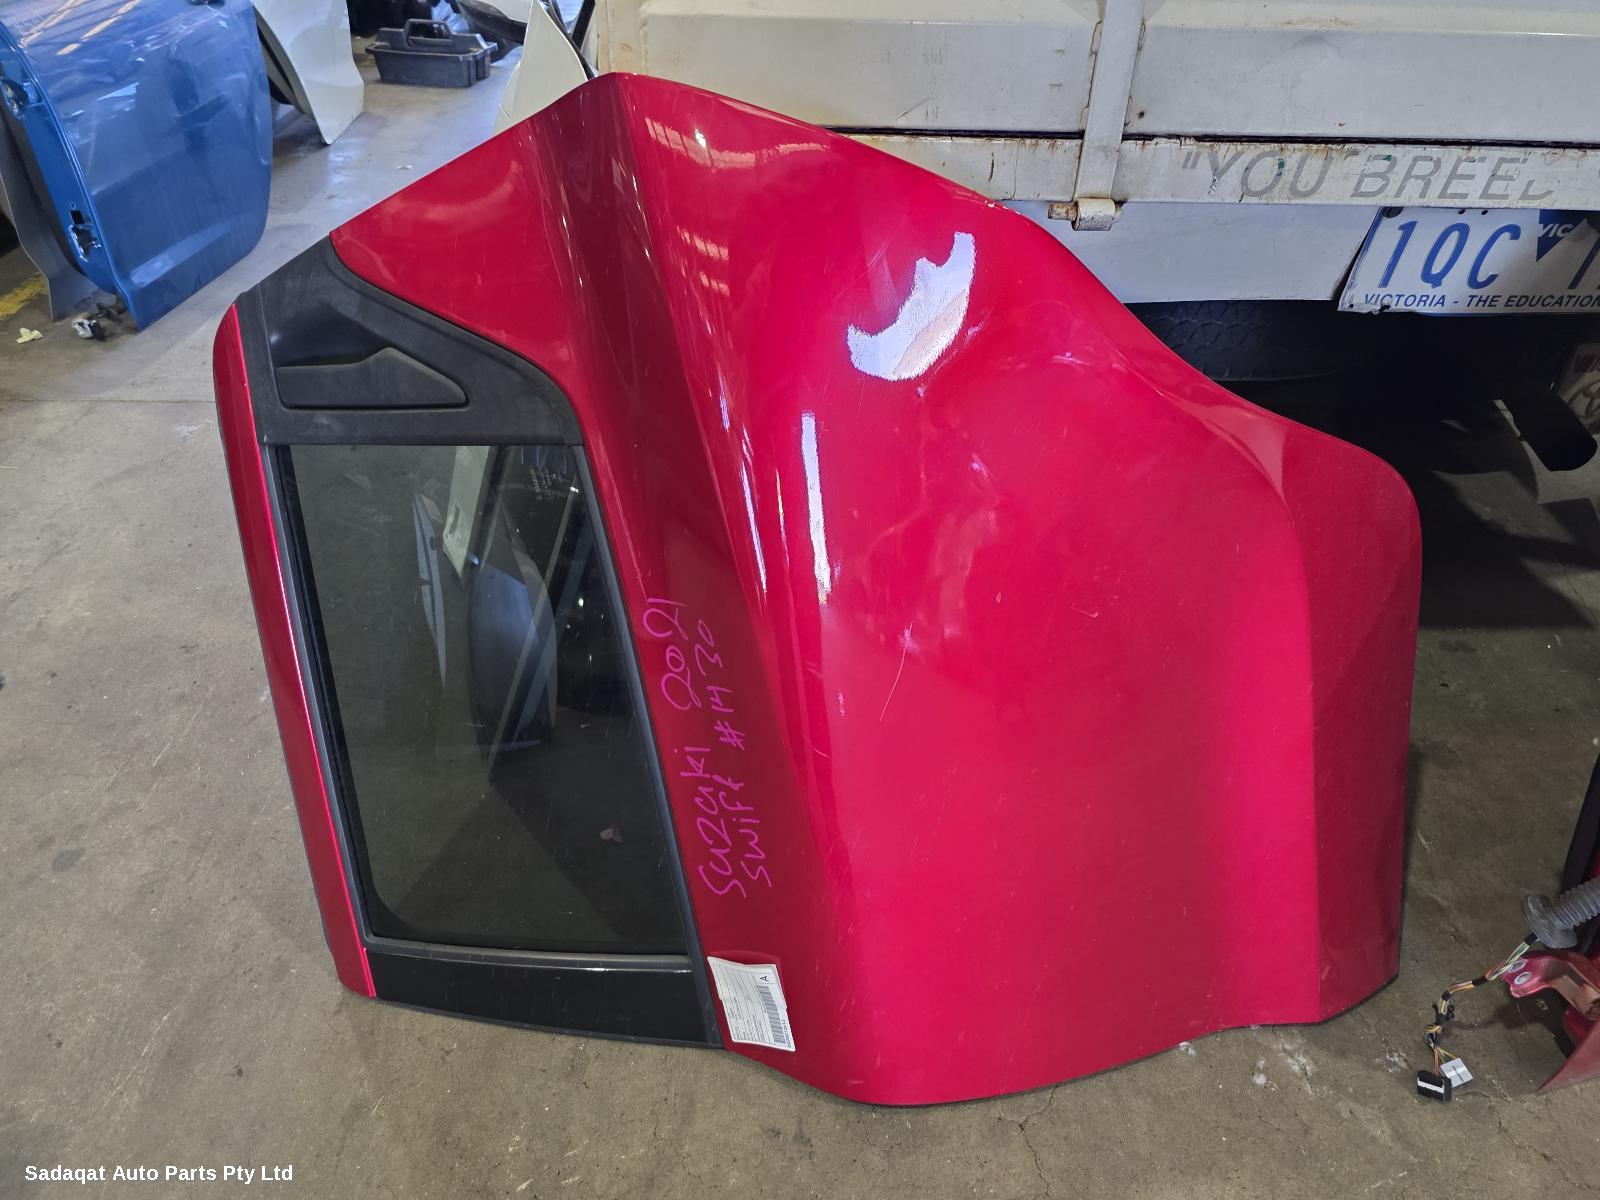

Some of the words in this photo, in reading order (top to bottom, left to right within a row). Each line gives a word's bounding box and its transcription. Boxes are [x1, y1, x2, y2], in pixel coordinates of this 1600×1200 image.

[1378, 220, 1521, 290] 1QC
[1364, 294, 1445, 308] VICTORIA
[1466, 295, 1502, 308] THE
[643, 597, 702, 711] 2021
